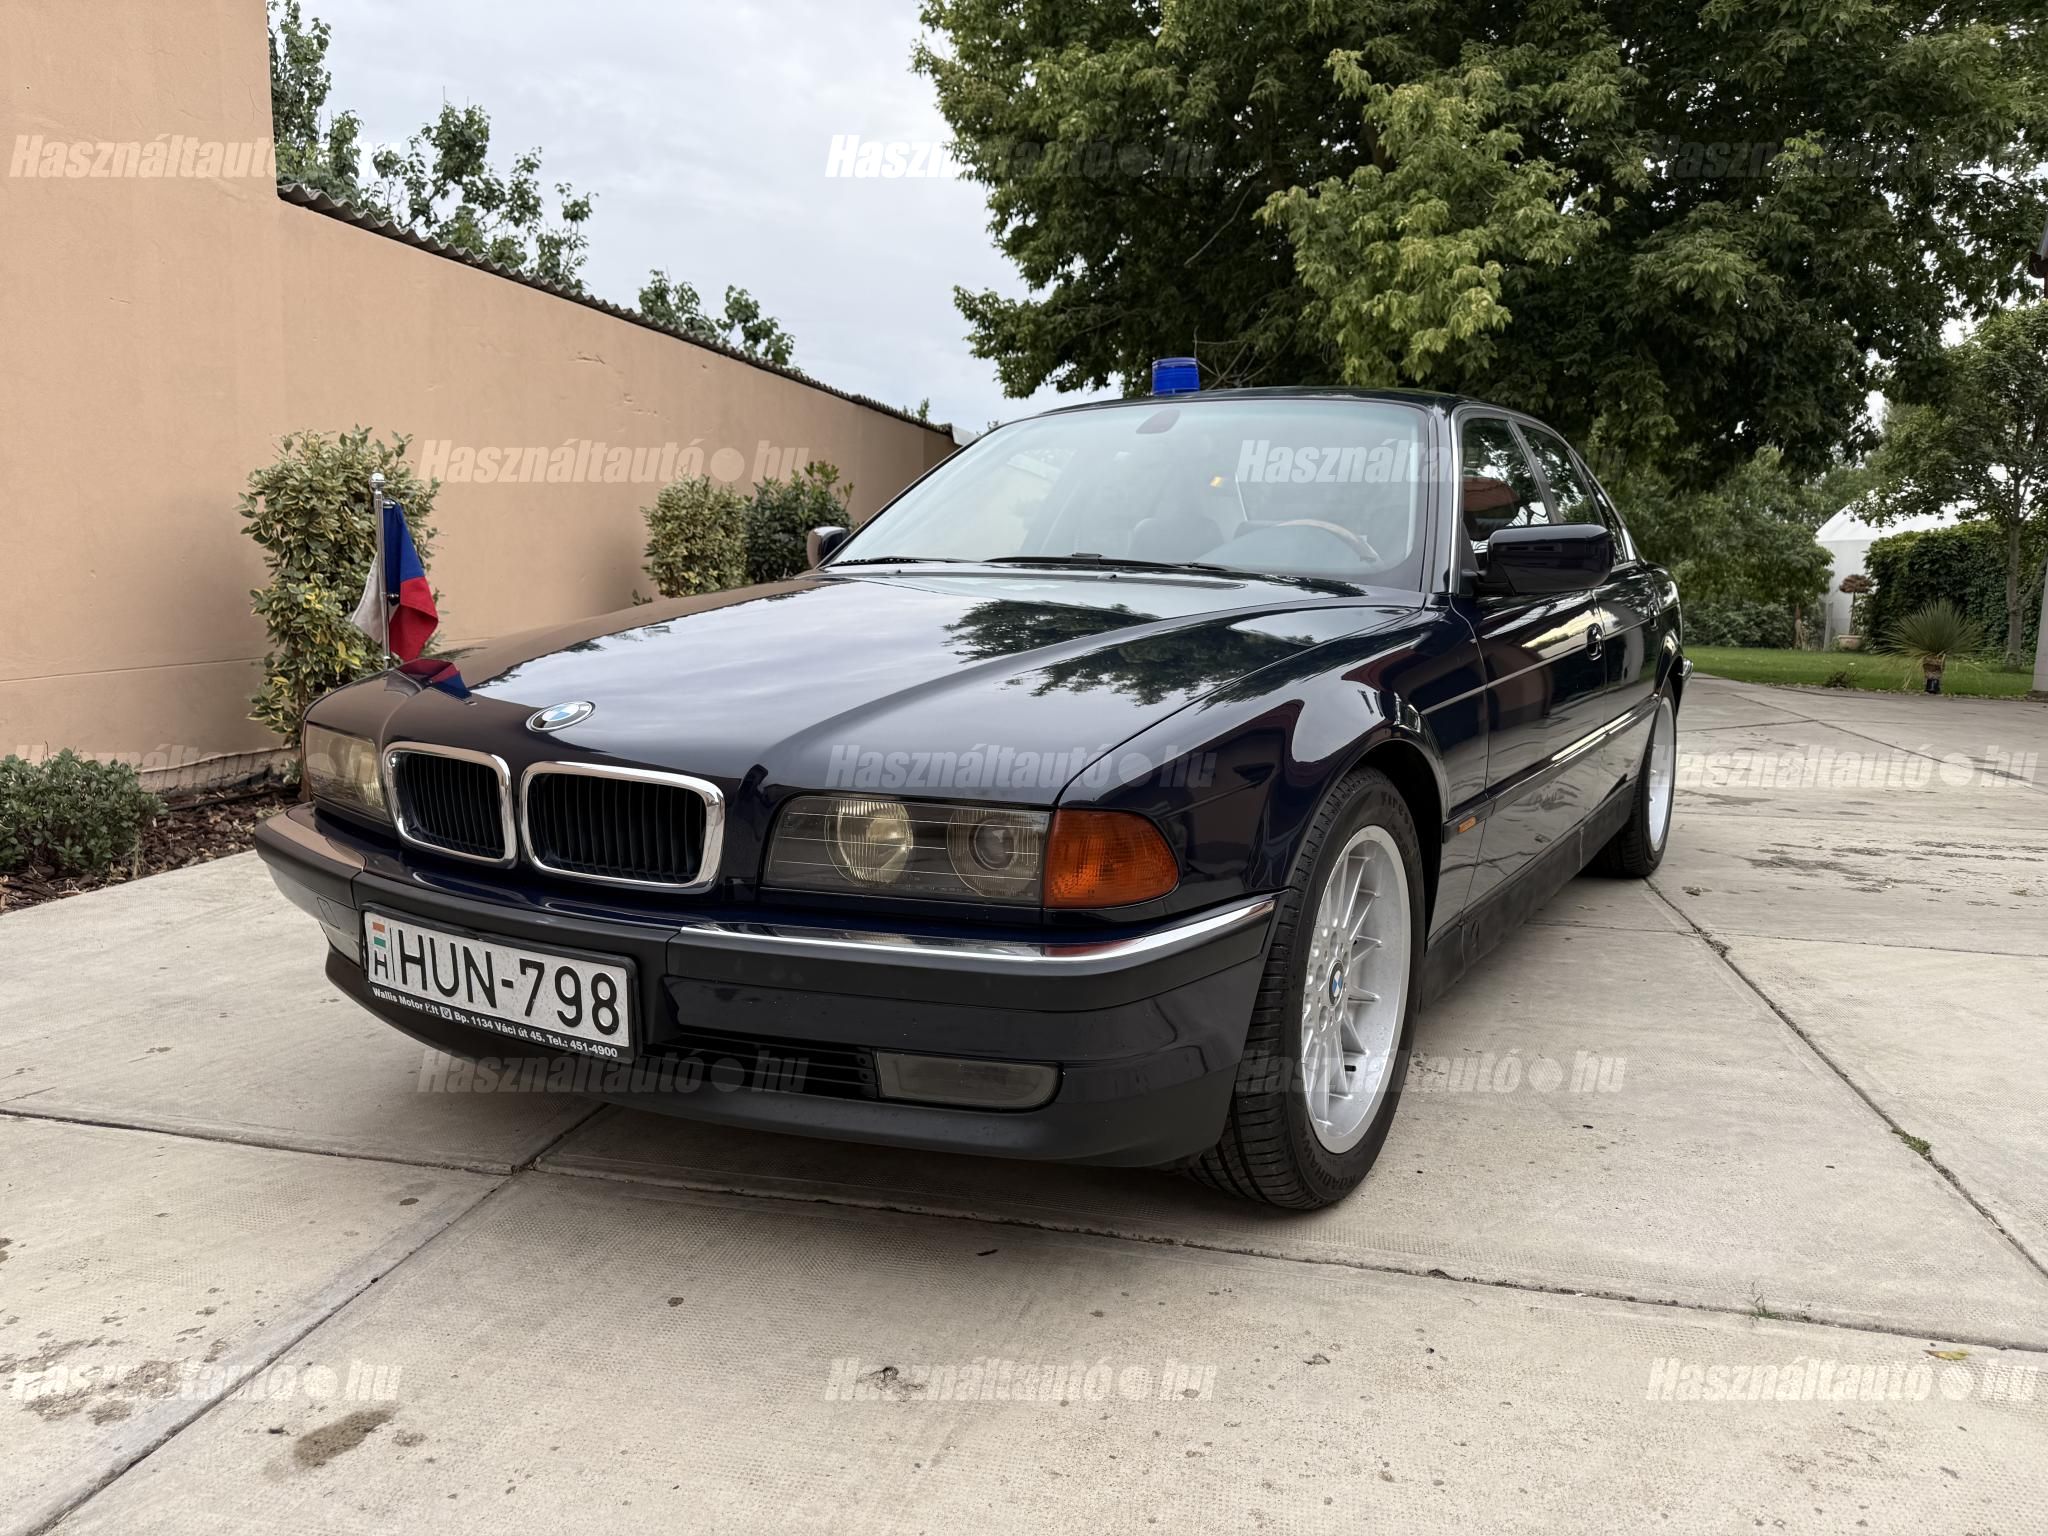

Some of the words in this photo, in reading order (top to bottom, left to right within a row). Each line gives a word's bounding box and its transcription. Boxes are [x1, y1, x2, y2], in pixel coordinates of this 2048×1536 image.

[373, 950, 388, 980] H
[399, 929, 620, 1036] HUN-798
[372, 986, 398, 1003] Wallis
[399, 995, 423, 1010] Motor
[453, 1012, 470, 1023] Bp.
[471, 1016, 494, 1029] 1134
[495, 1021, 517, 1036] Váci
[518, 1027, 529, 1038] út
[529, 1031, 546, 1042] 45.
[546, 1034, 569, 1048] Tel.:
[570, 1040, 618, 1058] 451-4900
